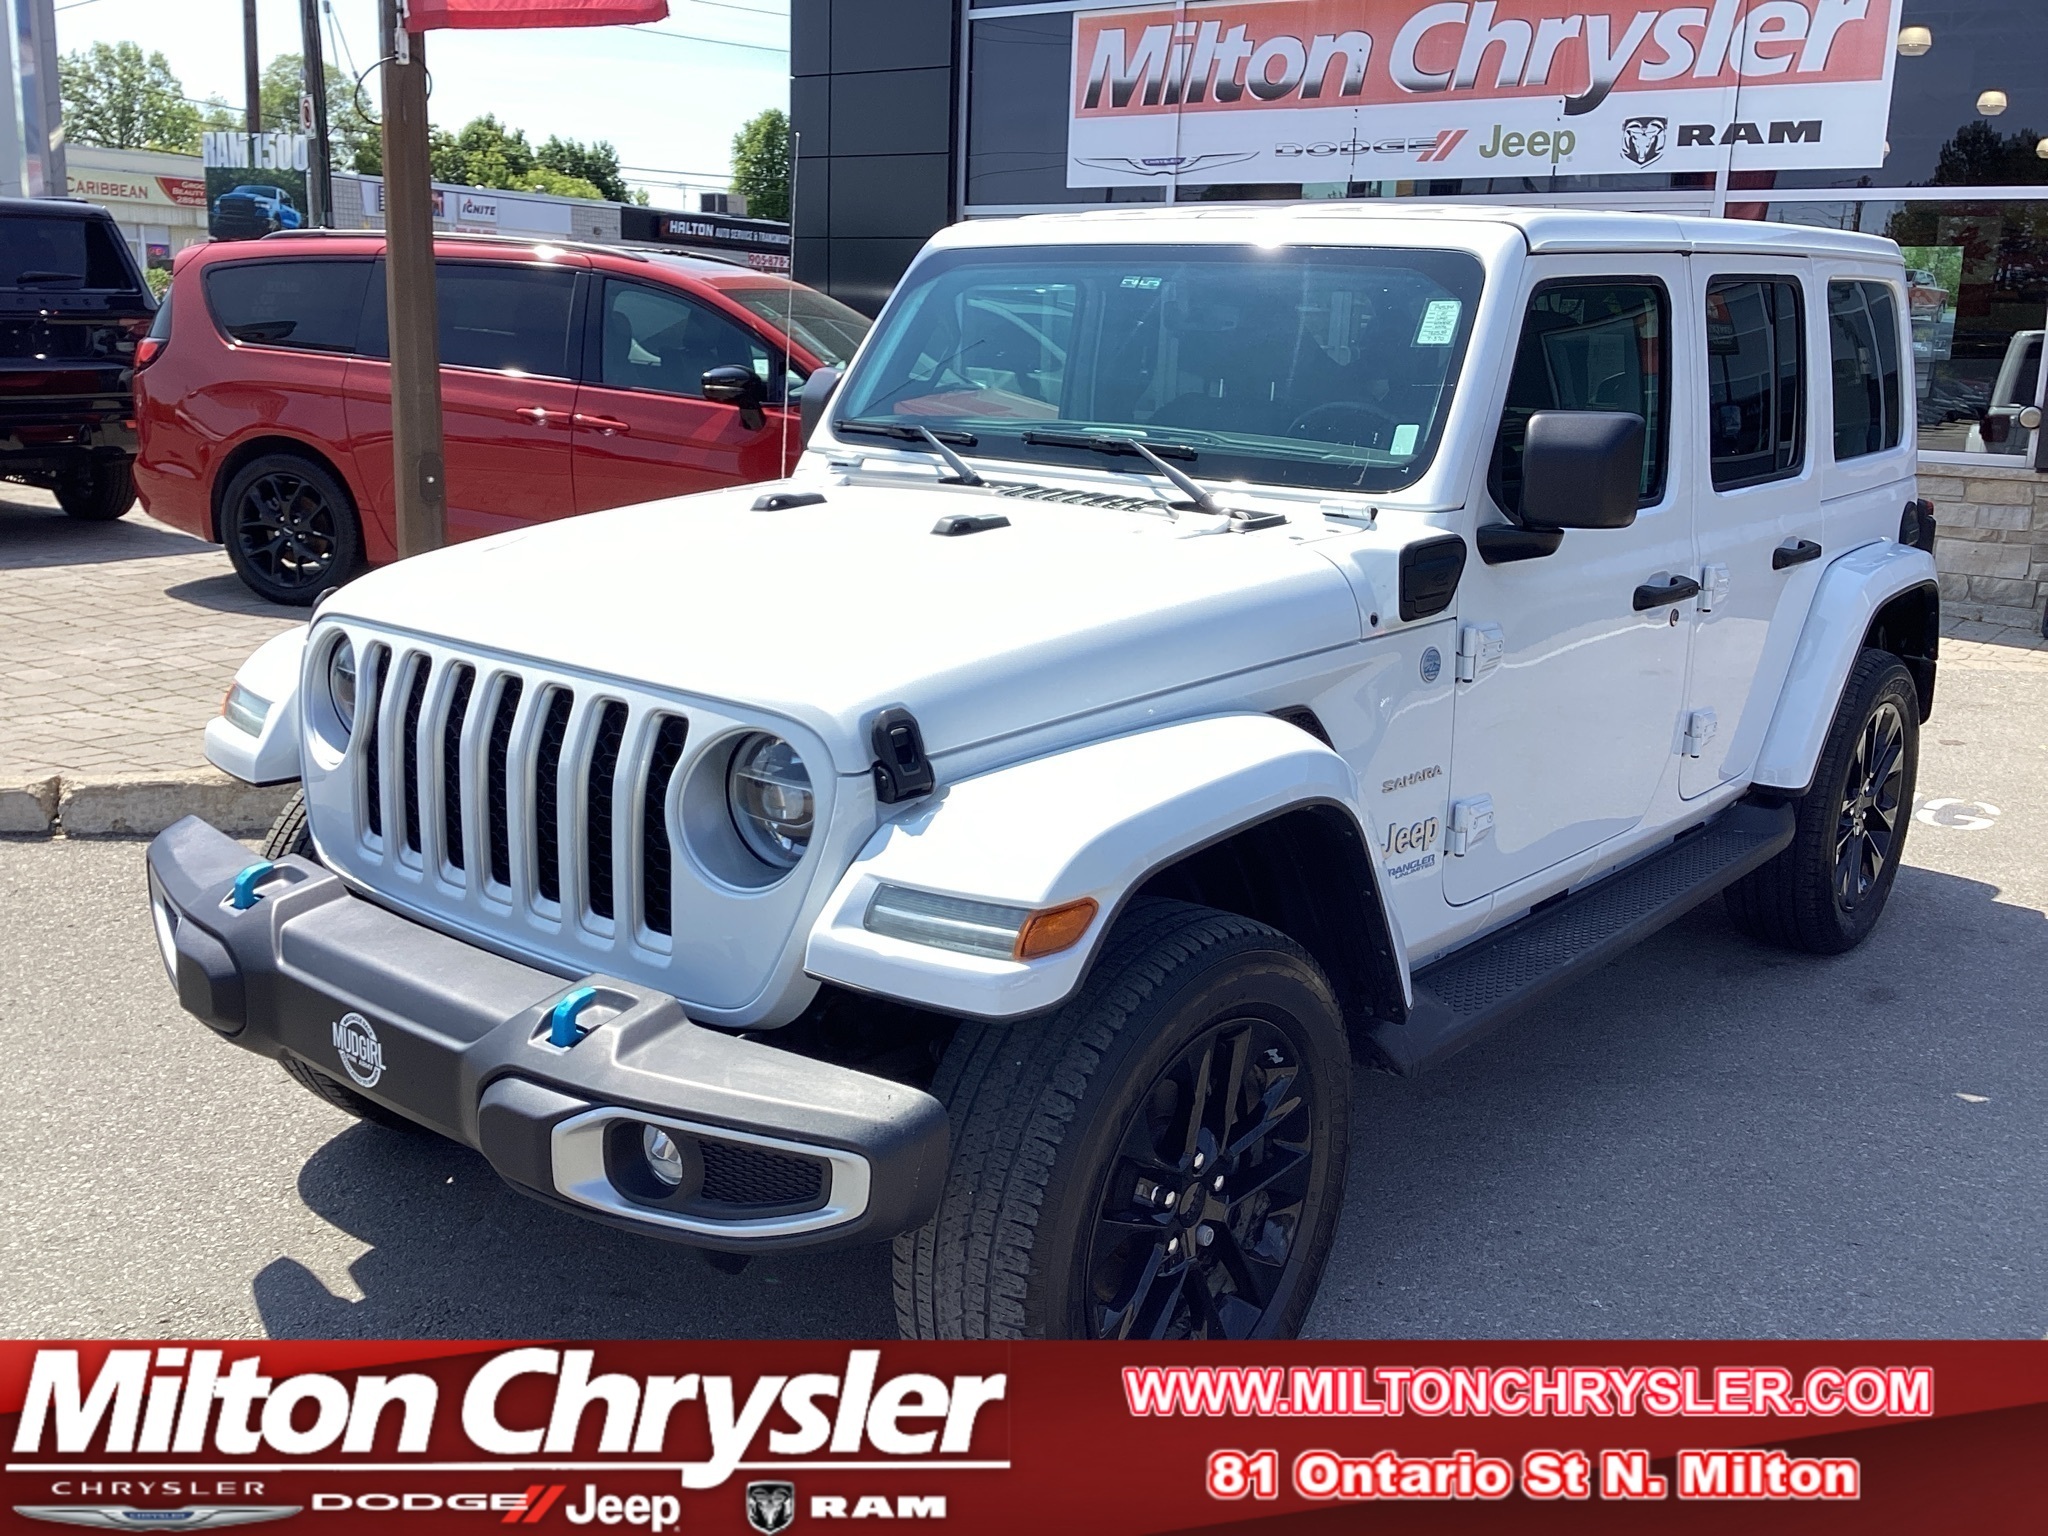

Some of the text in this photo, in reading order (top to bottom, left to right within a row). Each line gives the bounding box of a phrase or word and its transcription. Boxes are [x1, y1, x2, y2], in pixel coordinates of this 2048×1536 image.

[1082, 0, 1870, 116] Milton Chrysler
[1275, 136, 1441, 157] DODGE
[1479, 124, 1576, 164] Jeep
[1677, 120, 1823, 147] RAM
[202, 132, 308, 171] RAM 1500
[462, 201, 497, 216] IGNITE
[669, 220, 714, 237] HALTON
[1382, 765, 1443, 793] SAHARA
[1381, 816, 1439, 860] Jeep
[1394, 861, 1435, 879] UNLIMITED
[332, 1021, 387, 1071] MUDGIRL
